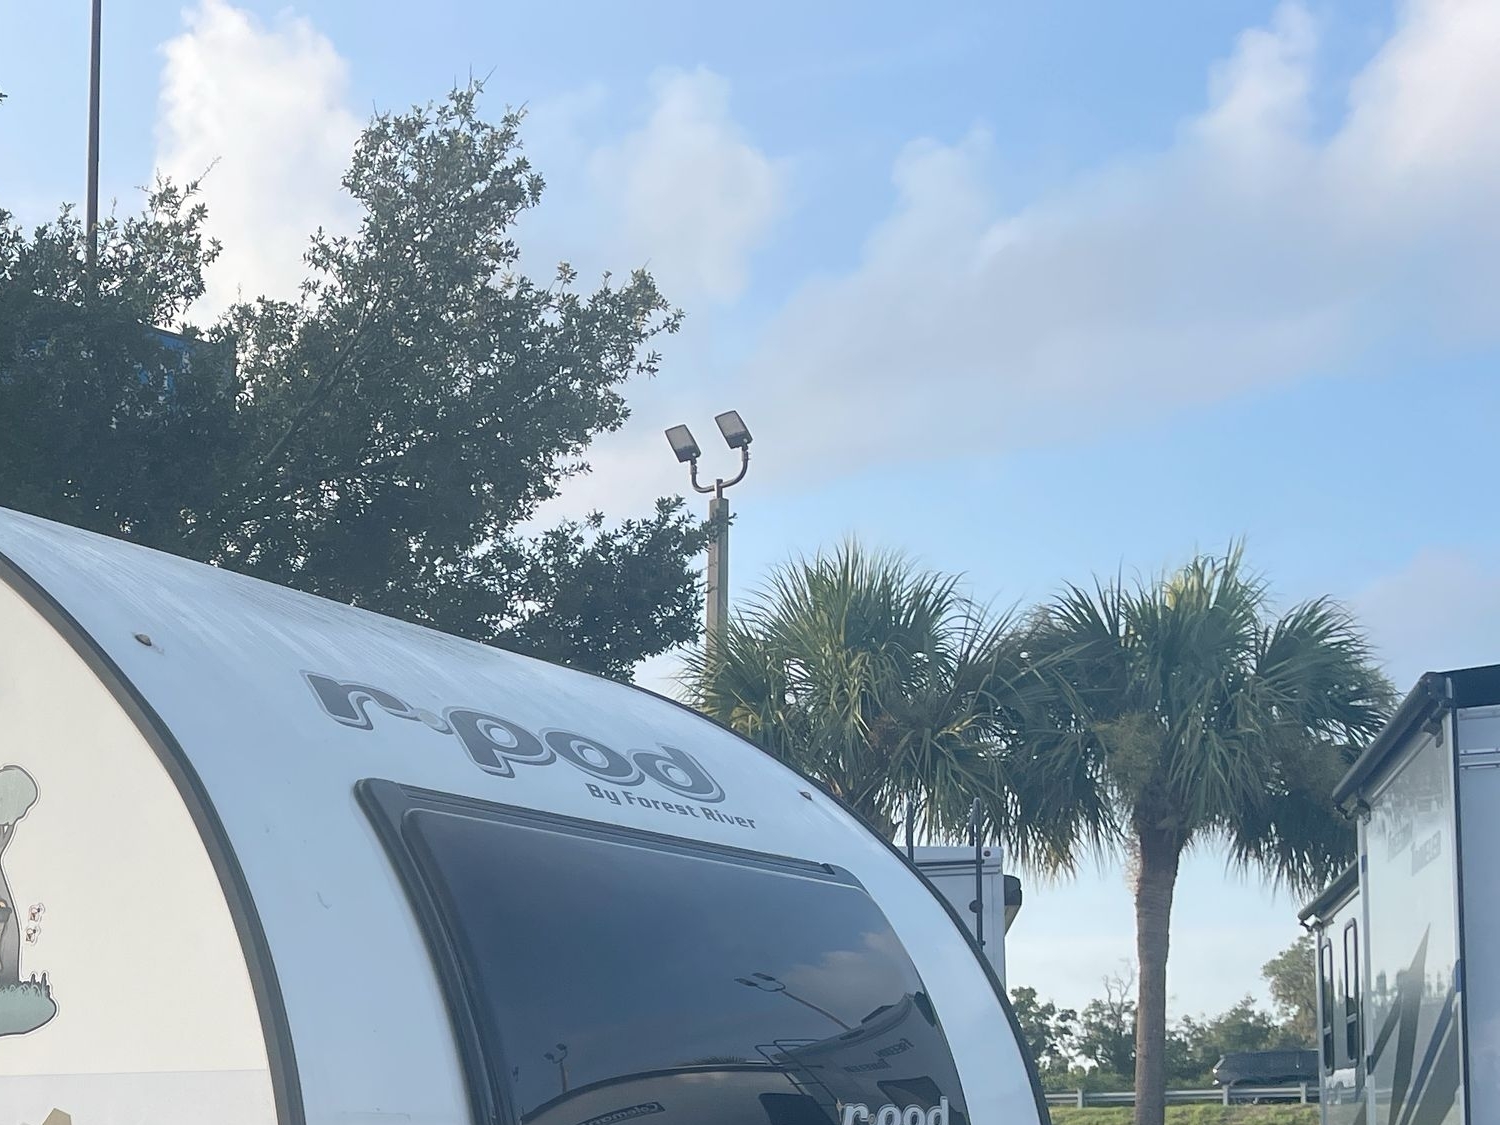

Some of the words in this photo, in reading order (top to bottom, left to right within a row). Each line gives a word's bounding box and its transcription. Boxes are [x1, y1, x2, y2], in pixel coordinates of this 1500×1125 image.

[584, 783, 624, 807] By
[624, 790, 701, 818] Forest
[703, 805, 758, 831] River
